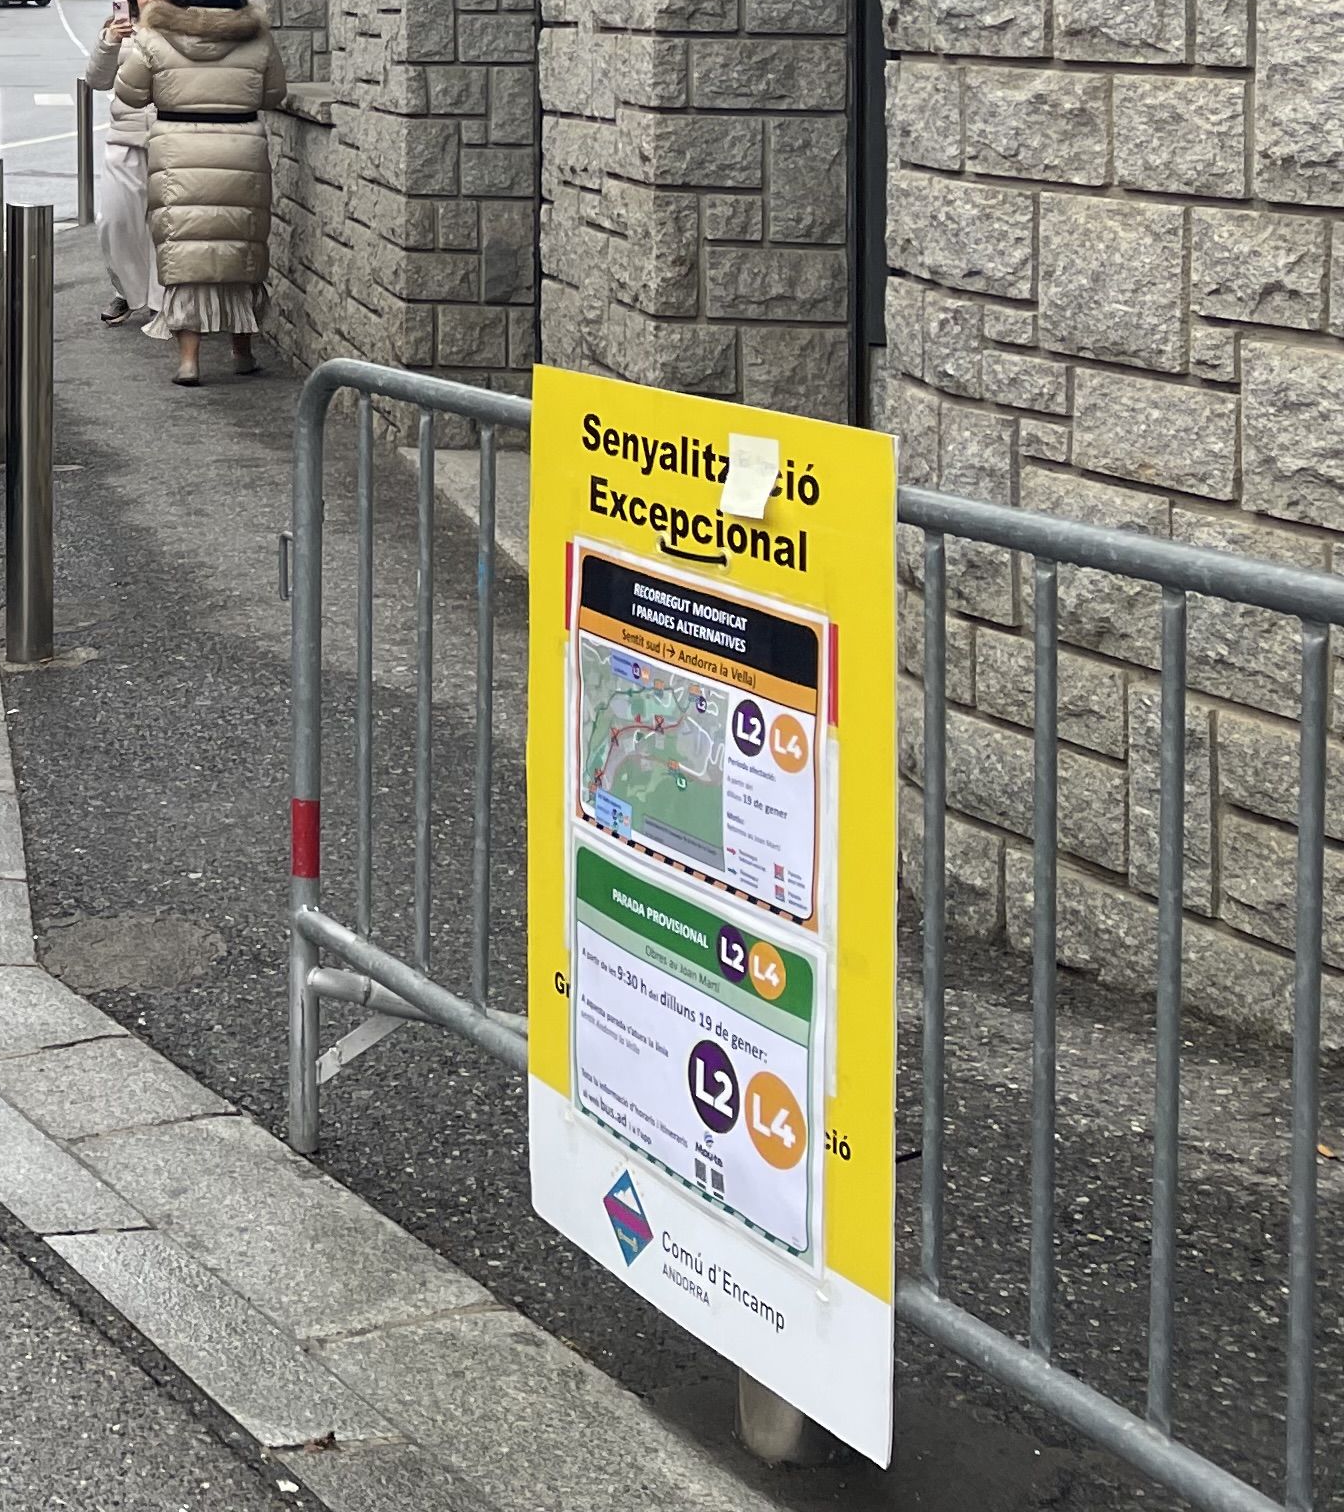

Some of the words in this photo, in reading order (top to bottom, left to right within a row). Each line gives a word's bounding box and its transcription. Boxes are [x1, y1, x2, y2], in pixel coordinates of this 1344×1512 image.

[589, 474, 808, 573] Excepcional
[633, 582, 691, 613] RECORREGUT
[691, 601, 748, 632] MODIFICAT
[635, 604, 676, 630] PARADES
[676, 621, 747, 653] ALTERNATIVES
[645, 636, 661, 655] sud
[678, 649, 717, 675] Andorra
[719, 662, 729, 678] la
[736, 711, 762, 746] L2
[774, 728, 803, 760] L4
[612, 888, 646, 918] PARADA
[646, 906, 709, 949] PROVISIONAL
[721, 936, 745, 973] L2
[754, 955, 780, 988] L4
[617, 965, 638, 990] 9:30
[640, 977, 647, 996] h
[660, 991, 696, 1023] dilluns
[699, 1012, 712, 1031] 19
[715, 1021, 729, 1042] de
[731, 1033, 768, 1065] gener:
[695, 1056, 733, 1119] L2
[752, 1092, 796, 1149] L4
[662, 1231, 703, 1276] Comú
[708, 1263, 785, 1334] d'Encamp
[662, 1263, 711, 1307] ANDORRA
